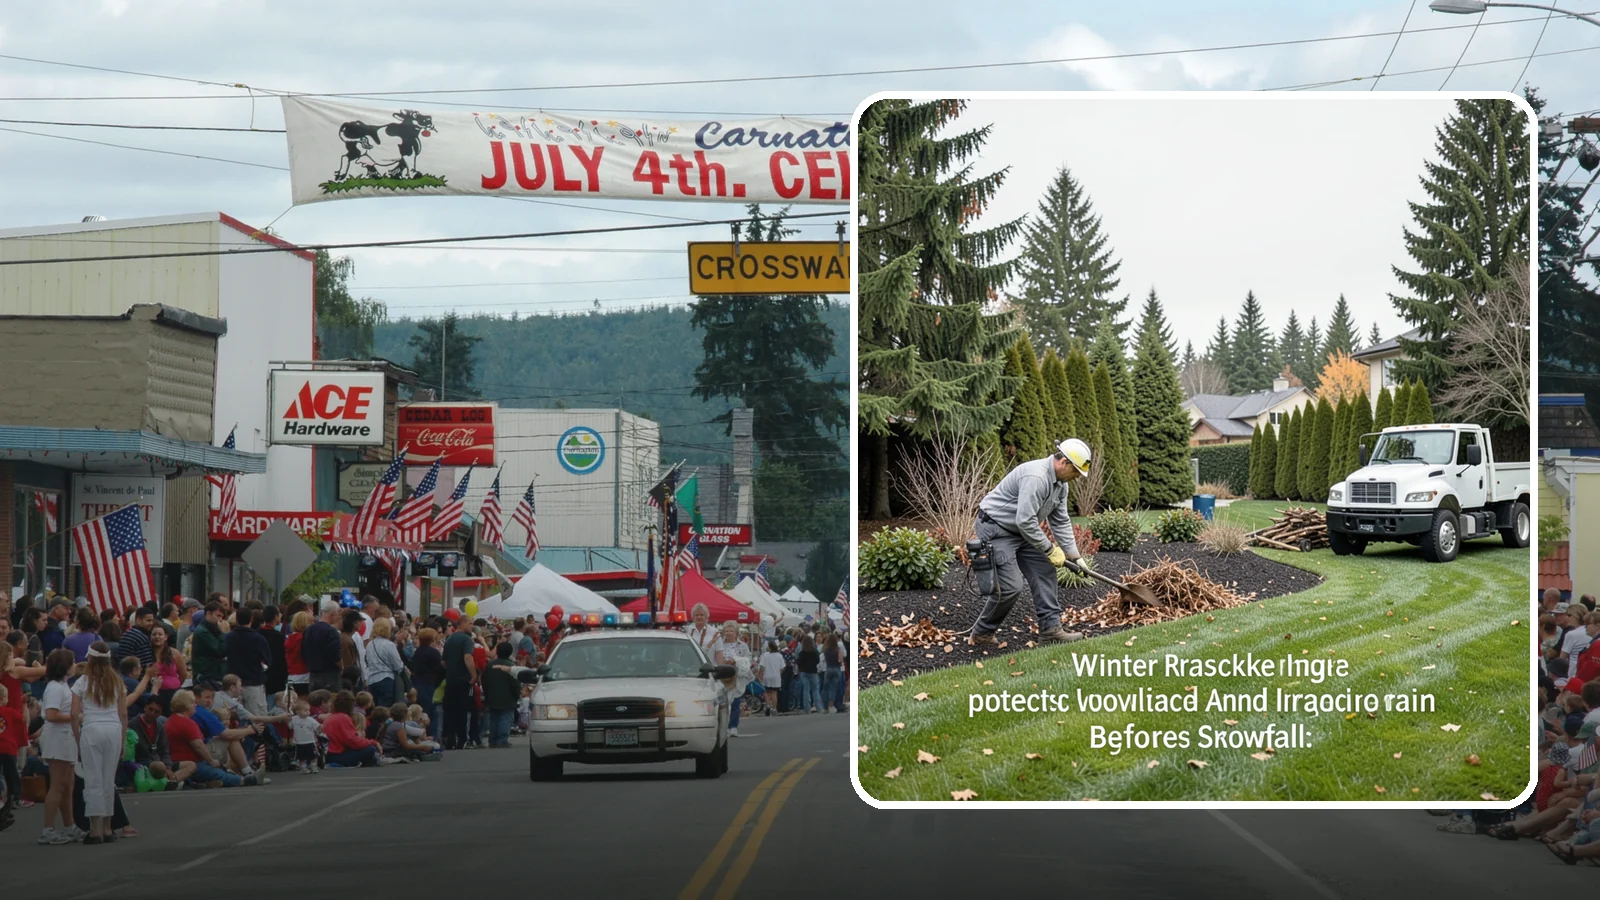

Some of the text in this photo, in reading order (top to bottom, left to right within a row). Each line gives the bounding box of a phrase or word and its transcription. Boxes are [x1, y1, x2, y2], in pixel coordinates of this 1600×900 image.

[481, 140, 605, 192] JULY
[632, 150, 746, 198] 4th.
[697, 254, 850, 280] CROSSWA
[283, 380, 373, 420] ACE
[406, 409, 485, 421] CEDAR LOG
[284, 421, 371, 436] Hardware
[416, 428, 477, 446] Coca-Cola
[83, 485, 155, 495] St. Vincent de Paul
[699, 535, 730, 543] GLASS
